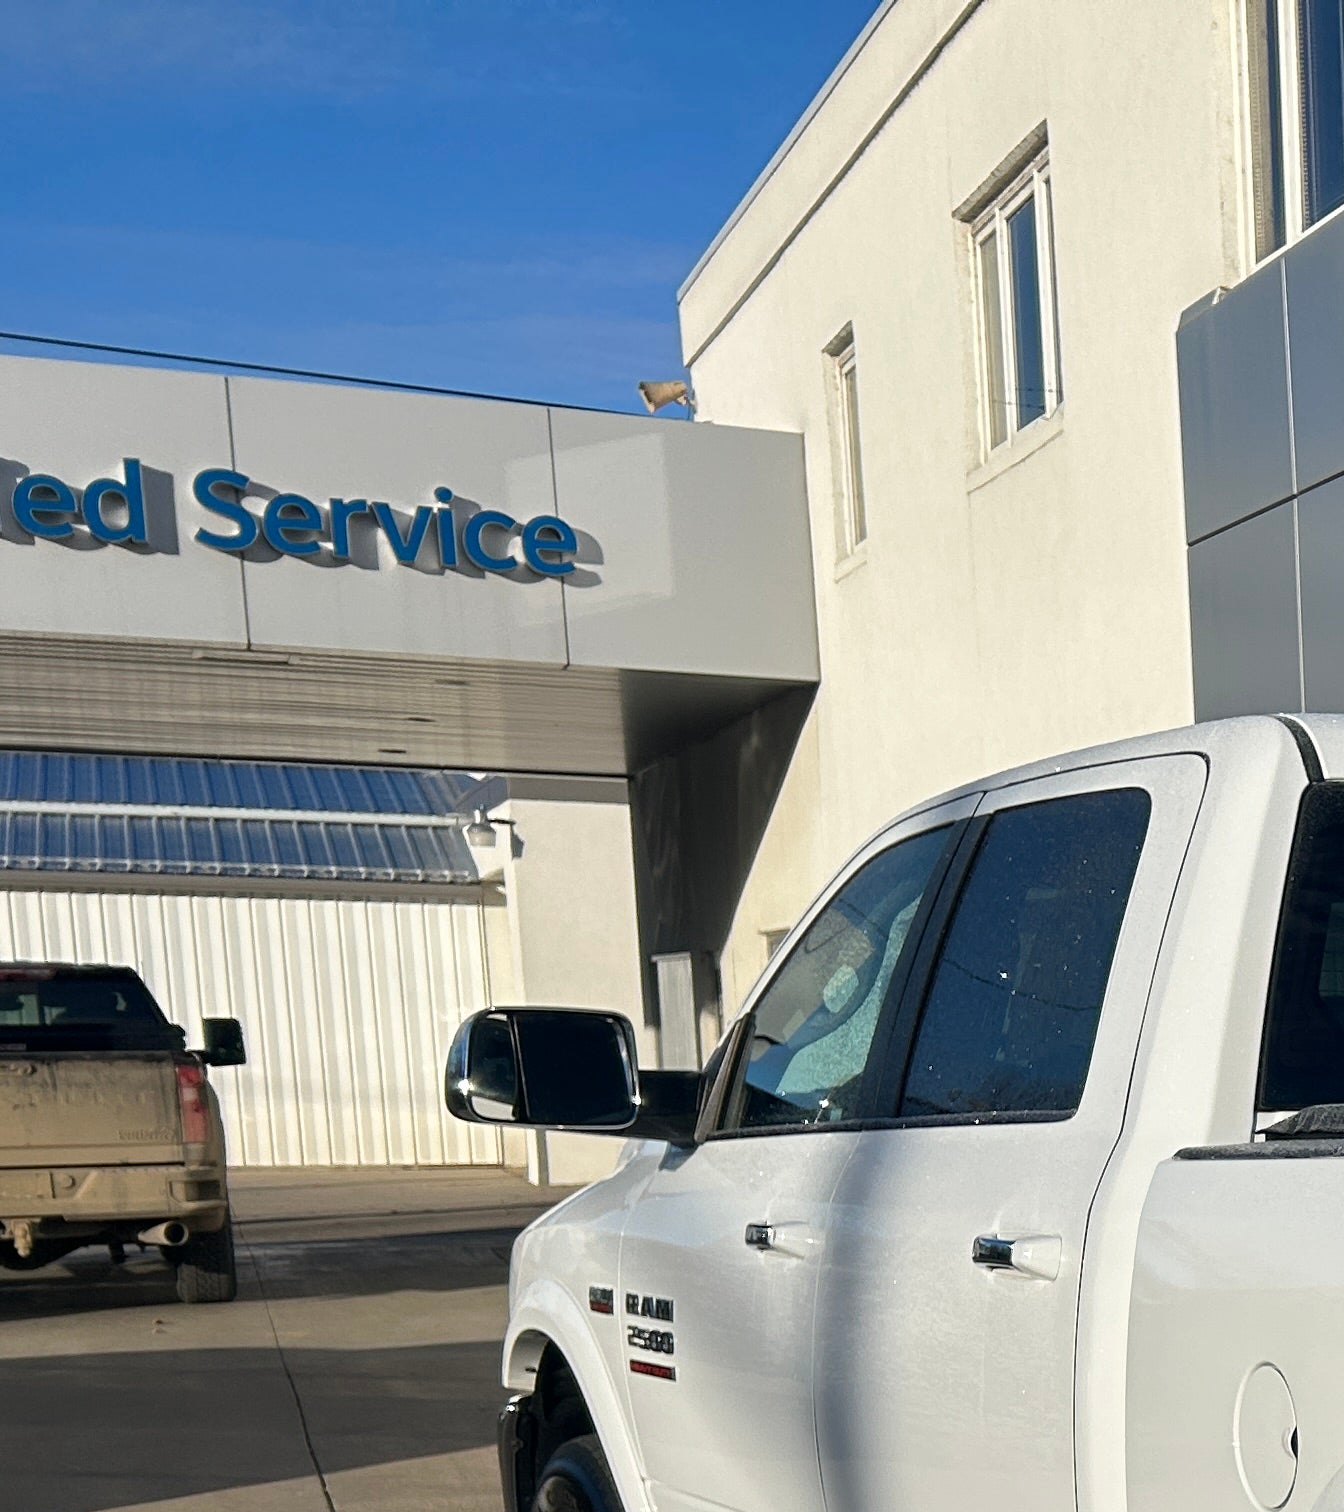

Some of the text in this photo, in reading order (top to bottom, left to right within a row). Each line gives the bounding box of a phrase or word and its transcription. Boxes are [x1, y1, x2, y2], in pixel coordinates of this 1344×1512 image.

[192, 467, 578, 577] Service
[625, 1293, 674, 1323] RAM
[627, 1325, 674, 1355] 2500
